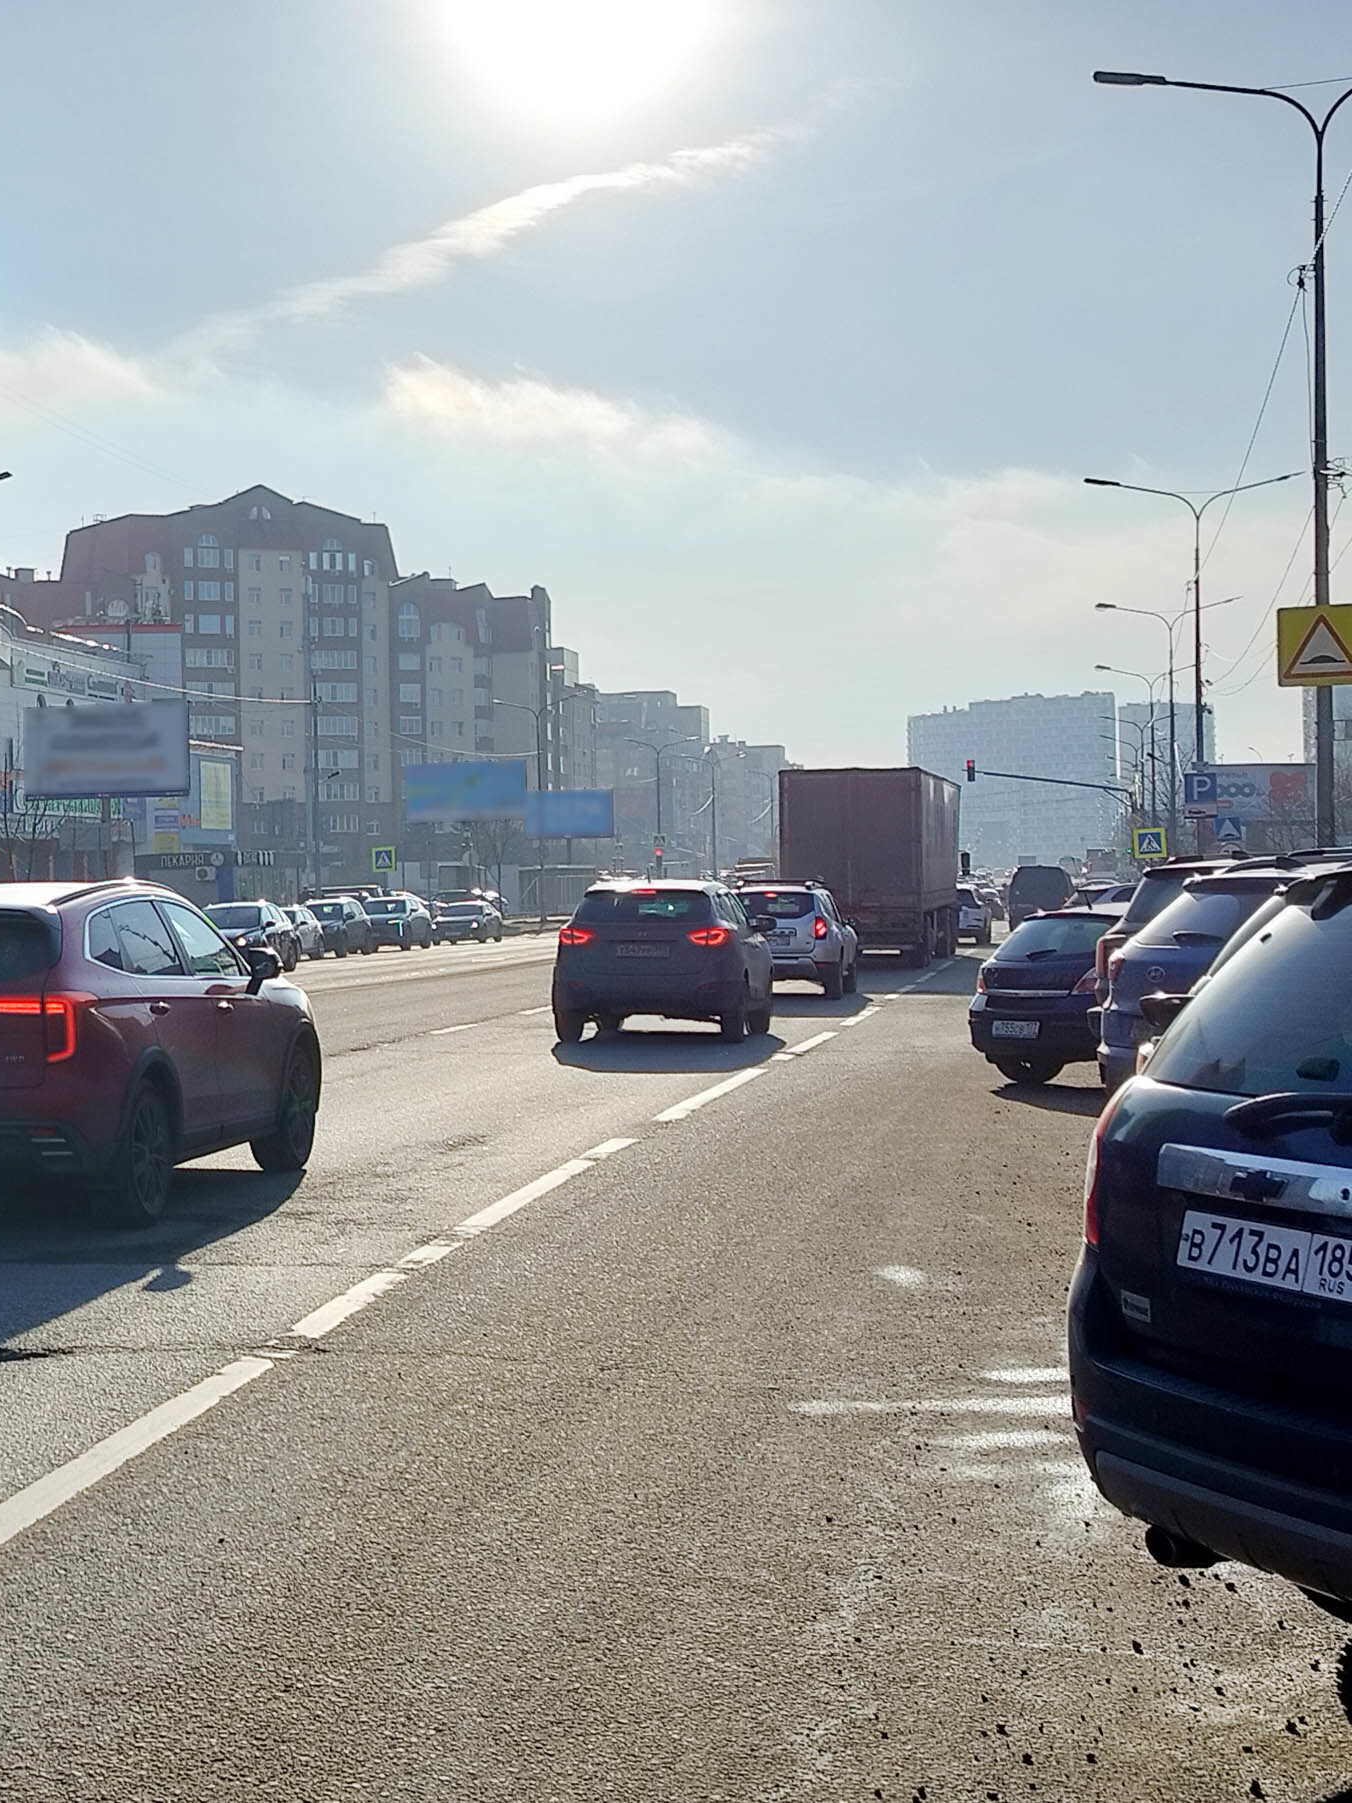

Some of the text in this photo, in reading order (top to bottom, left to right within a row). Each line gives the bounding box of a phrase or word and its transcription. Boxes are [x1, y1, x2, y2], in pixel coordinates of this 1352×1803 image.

[160, 855, 205, 867] ПЕКАРНЯ
[1187, 1221, 1300, 1284] В713ВА
[1318, 1277, 1345, 1295] RUS
